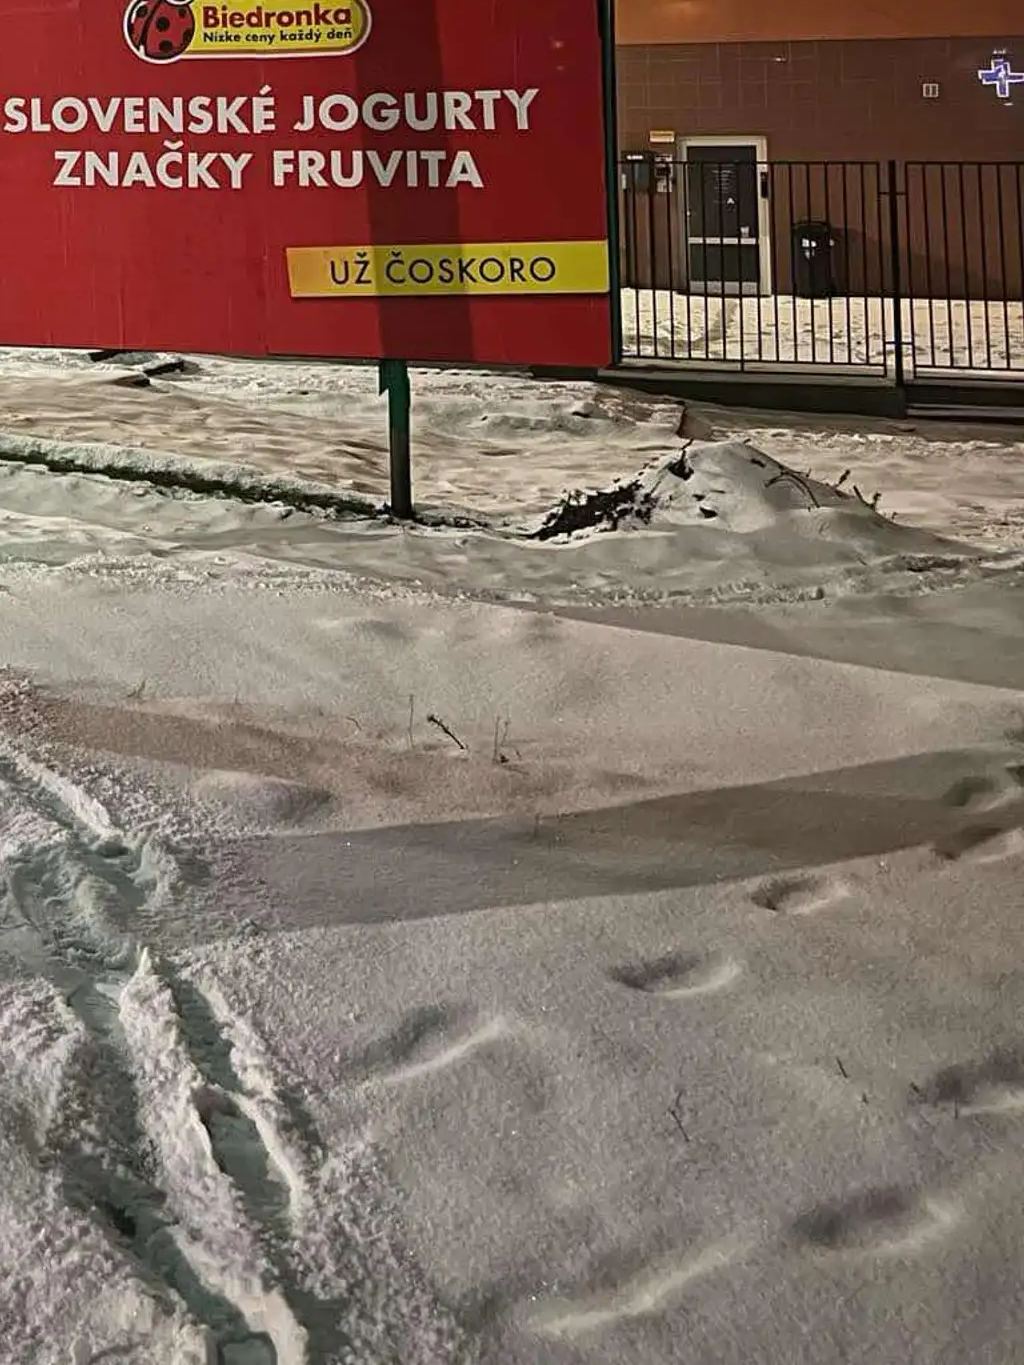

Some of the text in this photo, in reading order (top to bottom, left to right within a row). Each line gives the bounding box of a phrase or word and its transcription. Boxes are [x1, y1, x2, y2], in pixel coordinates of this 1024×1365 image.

[202, 3, 351, 28] Biedronka
[245, 32, 275, 45] ceny
[280, 29, 321, 43] každý
[327, 28, 352, 39] deň
[3, 84, 539, 134] SLOVENSKÉ JOGURTY
[53, 140, 484, 189] ZNAČKY FRUVITA
[330, 251, 557, 285] UŽ ČOSKORO
